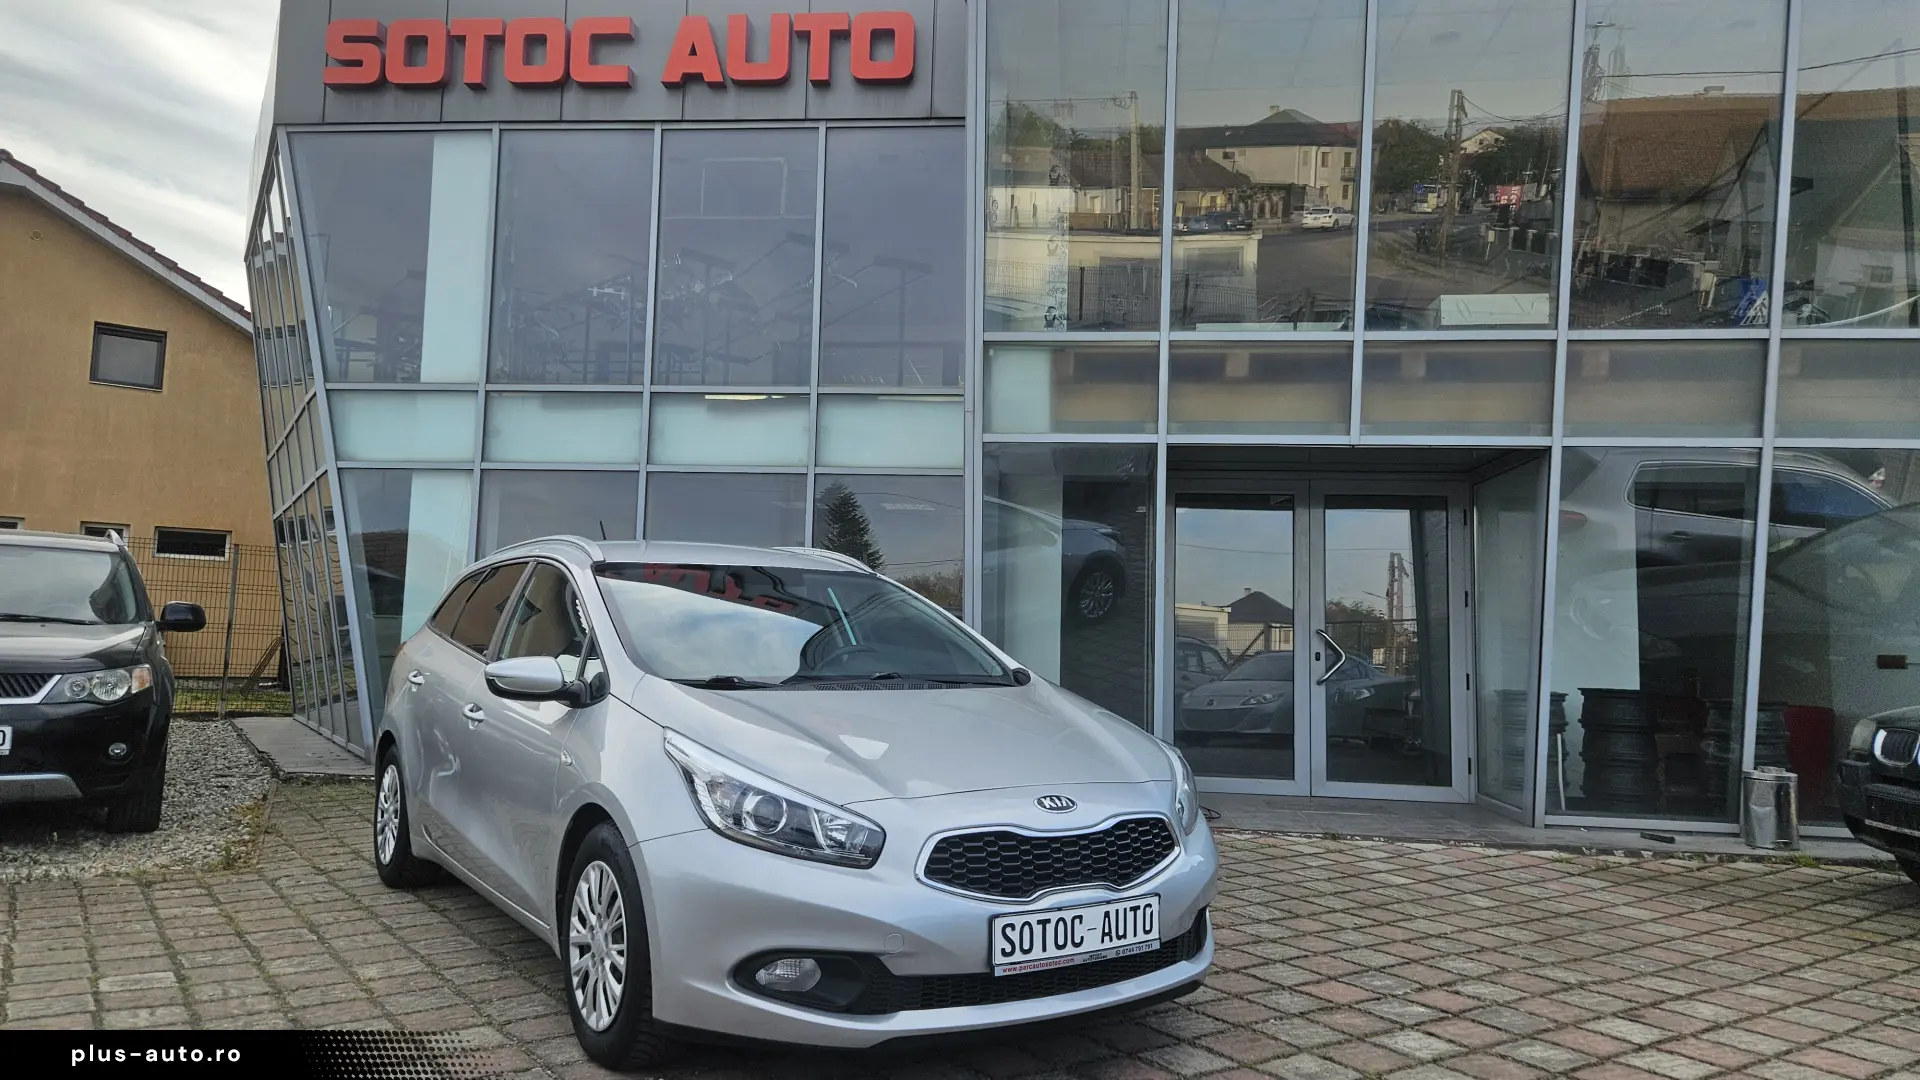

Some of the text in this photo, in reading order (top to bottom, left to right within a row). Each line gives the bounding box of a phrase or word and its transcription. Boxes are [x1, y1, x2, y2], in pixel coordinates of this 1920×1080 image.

[323, 11, 915, 90] SOTOC AUTO
[1040, 796, 1074, 809] KIA
[1000, 903, 1154, 958] SOTOC-AUTO
[1002, 957, 1075, 973] www.parcautosotoc.com
